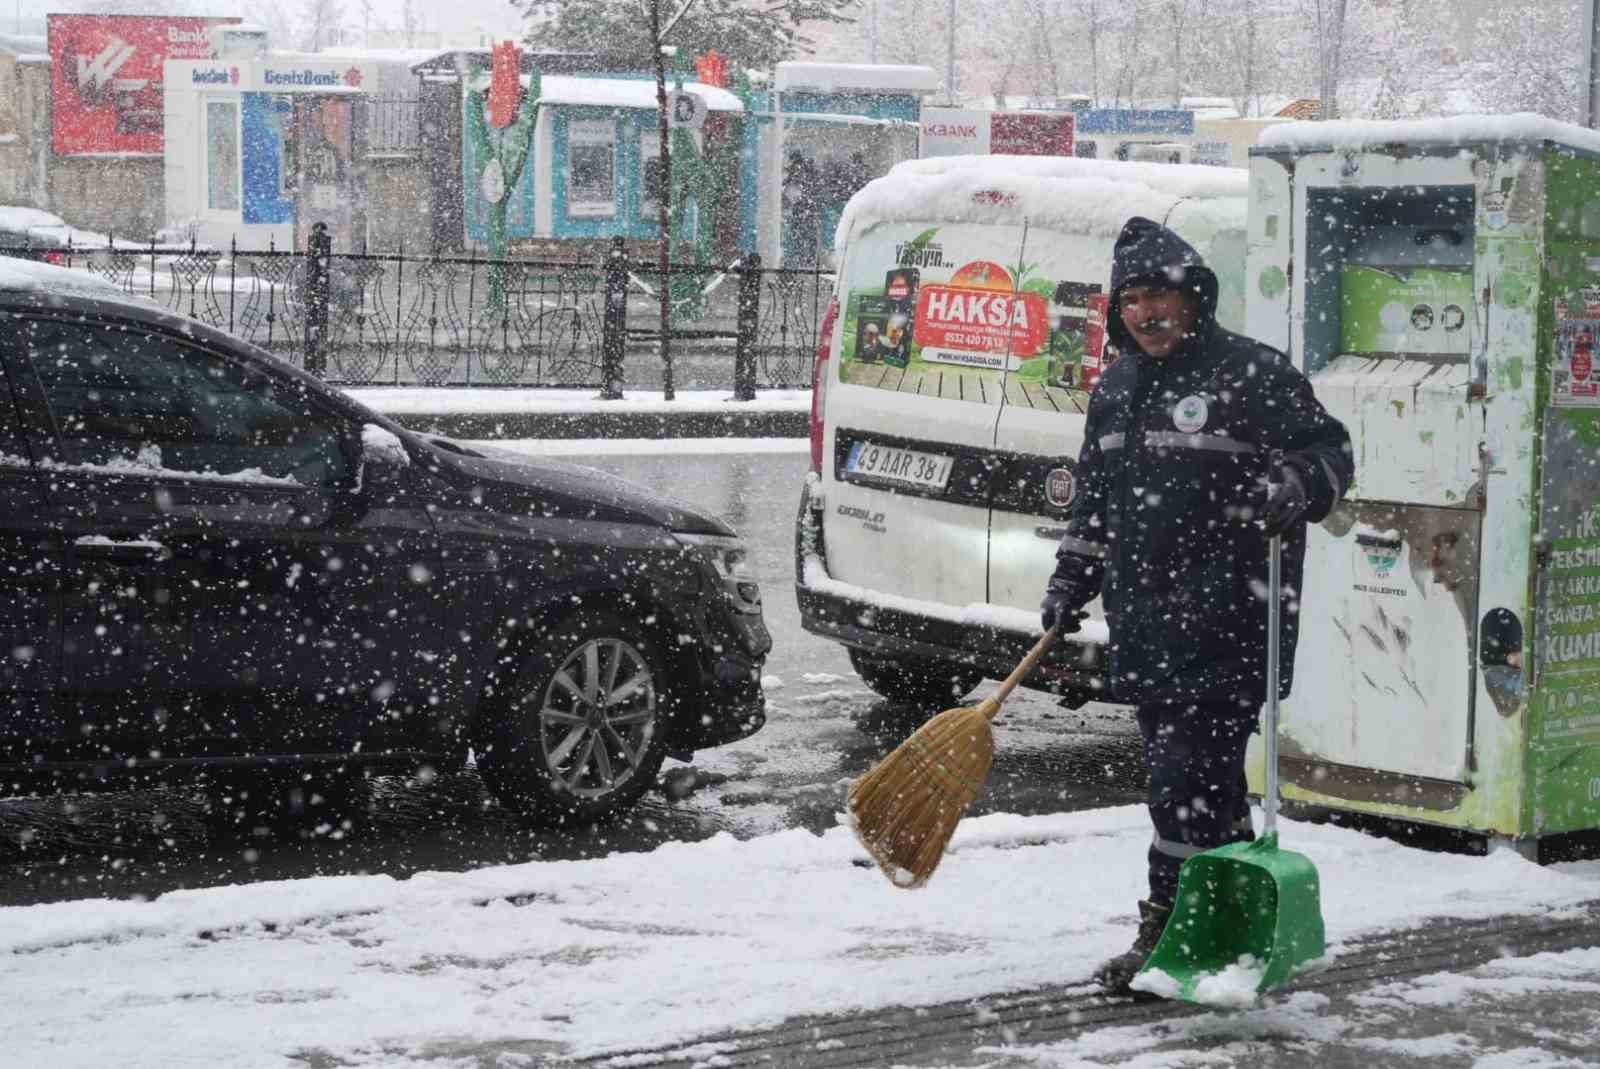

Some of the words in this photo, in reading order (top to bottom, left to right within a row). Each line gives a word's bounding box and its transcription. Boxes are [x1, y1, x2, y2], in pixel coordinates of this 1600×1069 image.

[926, 290, 1029, 329] HAKSA
[858, 446, 880, 471] 49
[880, 450, 913, 477] AAR
[914, 456, 947, 483] 381
